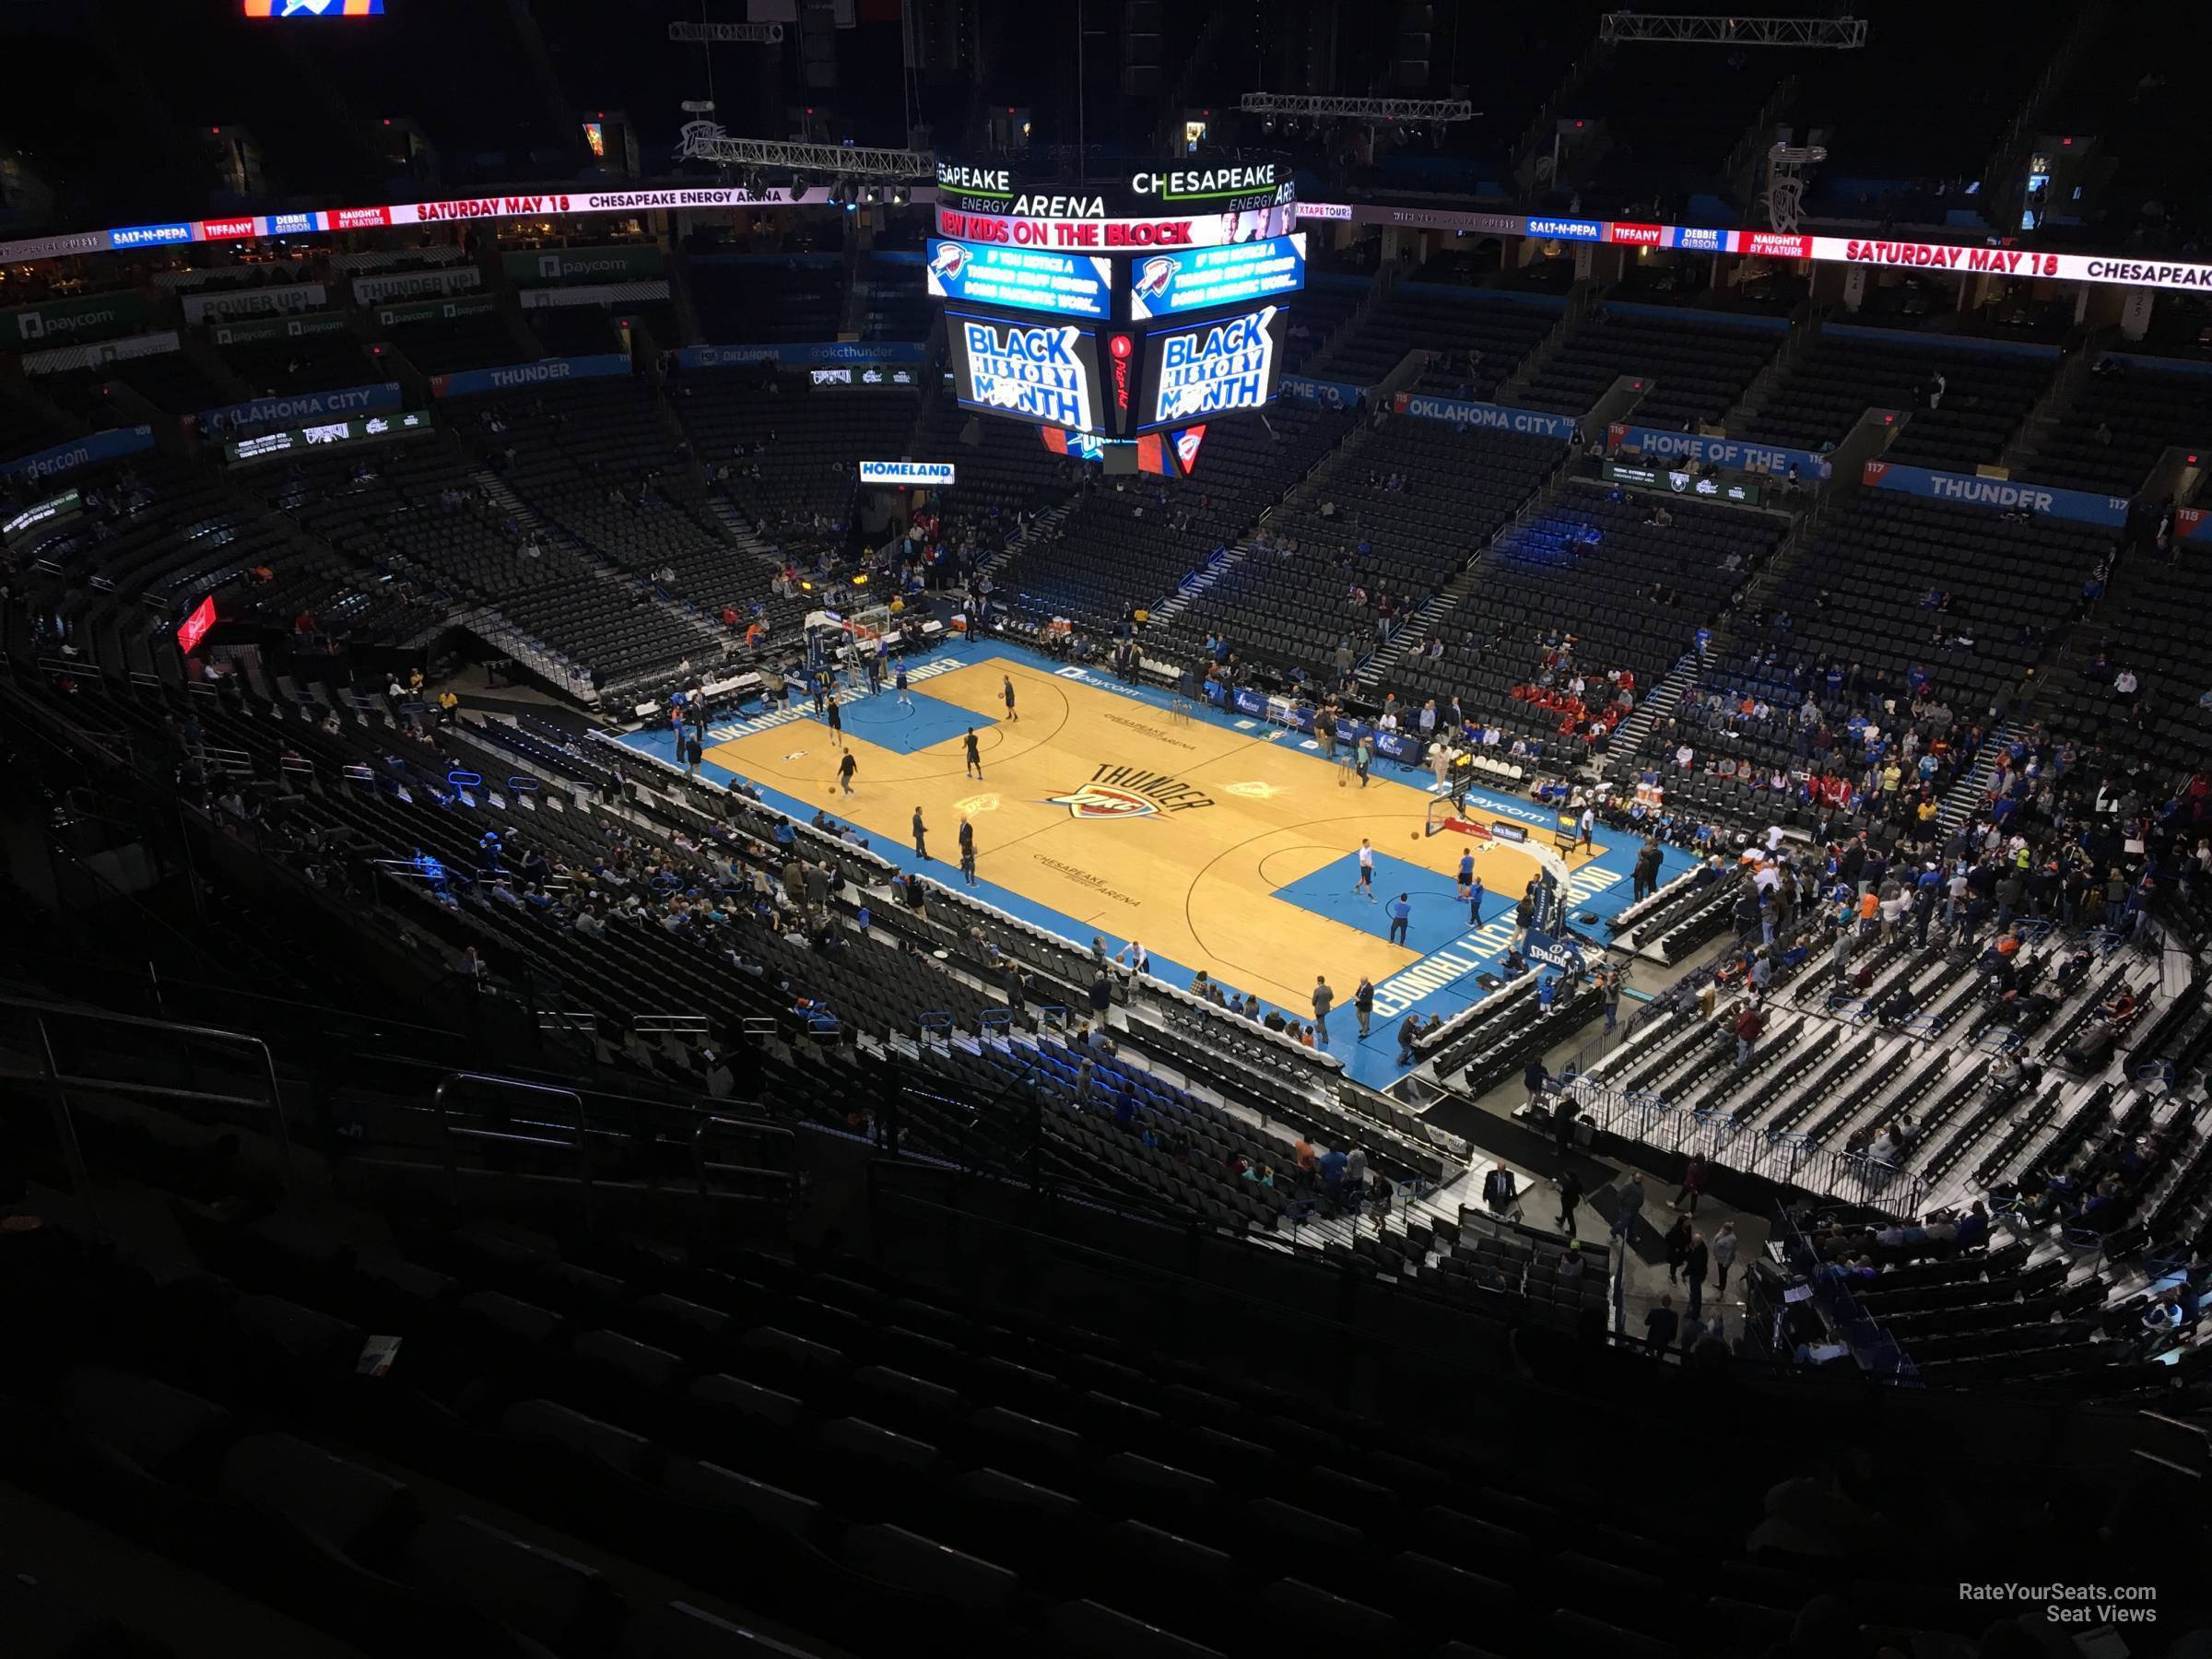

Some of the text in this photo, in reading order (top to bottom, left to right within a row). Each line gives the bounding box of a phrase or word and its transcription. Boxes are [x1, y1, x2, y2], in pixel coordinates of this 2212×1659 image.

[1132, 164, 1275, 194] CHESAPEAKE
[418, 189, 782, 220] SATURDAY MAY 18 CHESAPEAKE ENERGY ARNA
[961, 194, 1105, 218] ENERGY ARENA
[1228, 194, 1276, 213] ENERGY
[276, 215, 307, 224] DEBBIE
[339, 209, 381, 219] NAUGHTY
[205, 222, 253, 237] TIFFANY
[275, 223, 311, 233] GIBSON
[338, 217, 384, 228] BY NATURE
[940, 211, 1193, 246] NEW KIDS ON THE BLOCK
[1530, 222, 1596, 237] SALT-N-PEPA
[113, 227, 188, 245] SALT-N-PEPA
[1615, 228, 1659, 241] TIFFANY
[1684, 229, 1717, 240] DEBBIE
[1753, 234, 1802, 245] NAUGHTY
[1681, 239, 1718, 249] GIBSON
[1749, 243, 1803, 256] BY NATURE
[563, 258, 627, 275] paycom
[1846, 241, 1962, 268] SATURDAY
[1969, 250, 2023, 274] MAY
[2030, 253, 2059, 276] 18
[359, 274, 475, 300] THUNDER UP!
[203, 291, 308, 315] POWER UP!
[456, 304, 494, 317] paycom
[45, 310, 114, 333] paycom
[395, 311, 433, 324] paycom
[234, 328, 276, 341] paycom
[302, 320, 346, 335] paycom
[968, 324, 1072, 365] BLACK
[1165, 312, 1265, 369] BLACK
[723, 350, 780, 361] OKLAHOMA
[810, 346, 893, 359] @okcthunder
[490, 363, 570, 386] THUNDER
[971, 355, 1078, 392] HISTORY
[1162, 348, 1264, 389] HISTORY
[328, 391, 371, 411] CITY
[1395, 393, 1408, 403] 115
[1409, 399, 1558, 437] OKLAHOMA CITY
[1563, 417, 1575, 428] 115
[1610, 425, 1625, 436] 116
[1642, 433, 1787, 472] HOME OF THE
[1808, 453, 1824, 465] 116
[863, 463, 952, 477] HOMELAND
[1866, 463, 1885, 473] 117
[1931, 476, 2053, 512] THUNDER
[2109, 498, 2129, 510] 117
[2179, 509, 2199, 522] 118
[1076, 672, 1141, 698] paycom
[1104, 713, 1169, 736] CHESAPEAKE
[1161, 736, 1196, 751] ARENA
[1090, 763, 1216, 812] THUNDER
[1033, 853, 1108, 887] CHESAPEAKE
[1095, 887, 1142, 909] ARENA
[1370, 951, 1480, 1018] THUNDER
